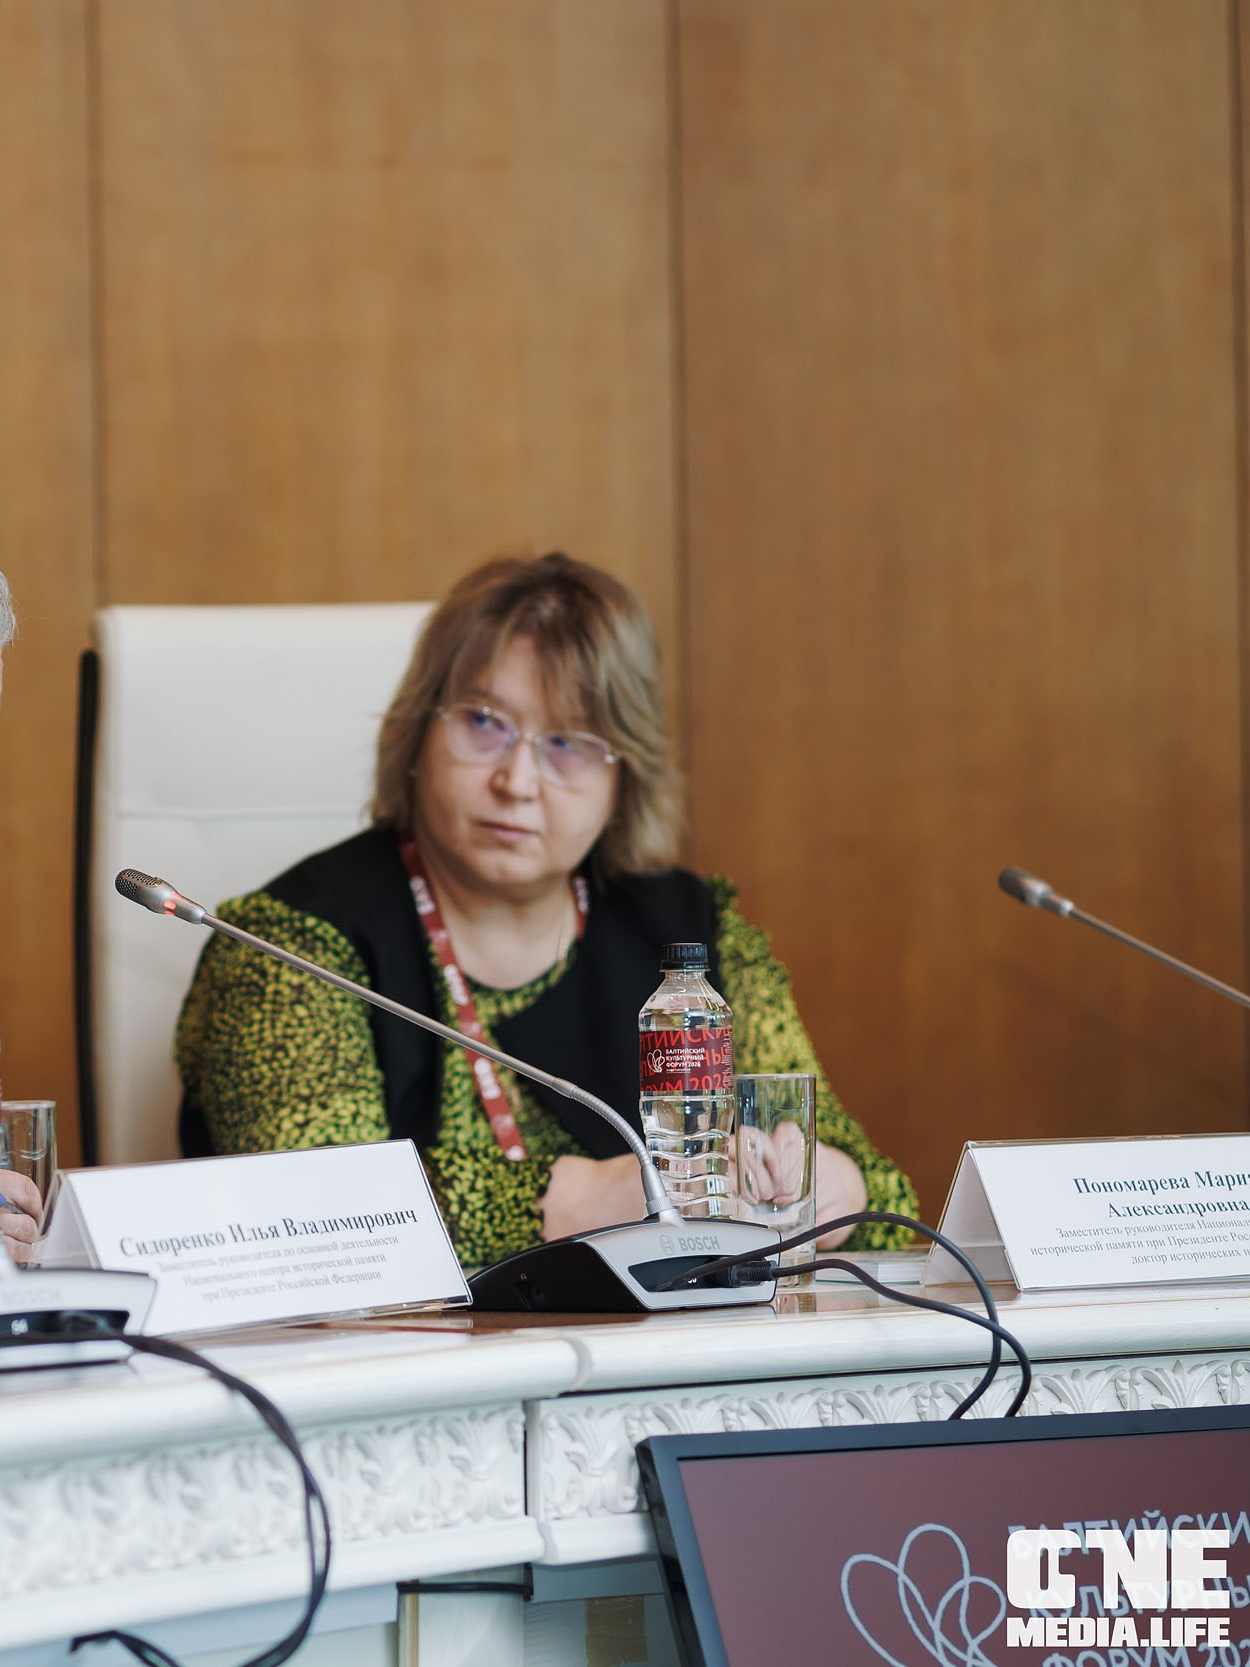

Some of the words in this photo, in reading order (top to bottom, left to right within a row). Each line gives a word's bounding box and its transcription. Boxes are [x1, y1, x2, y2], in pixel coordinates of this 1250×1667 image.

[1073, 1176, 1190, 1195] Пономарева
[1194, 1171, 1250, 1191] Мари
[1108, 1200, 1250, 1218] Александровна
[119, 1230, 226, 1257] Сидоренко
[228, 1223, 280, 1244] Илья
[282, 1209, 419, 1238] Владимирович
[1055, 1226, 1123, 1238] Заместитель
[1124, 1222, 1196, 1236] руководителя
[341, 1235, 399, 1250] деятельности
[678, 1235, 721, 1252] BOSCH
[1030, 1240, 1103, 1256] исторической
[1105, 1240, 1144, 1251] памяти
[1146, 1238, 1166, 1249] при
[1167, 1235, 1229, 1248] Президенте
[1230, 1231, 1250, 1242] Рос
[354, 1253, 387, 1265] памяти
[1131, 1253, 1167, 1265] доктор
[1170, 1248, 1242, 1262] исторических
